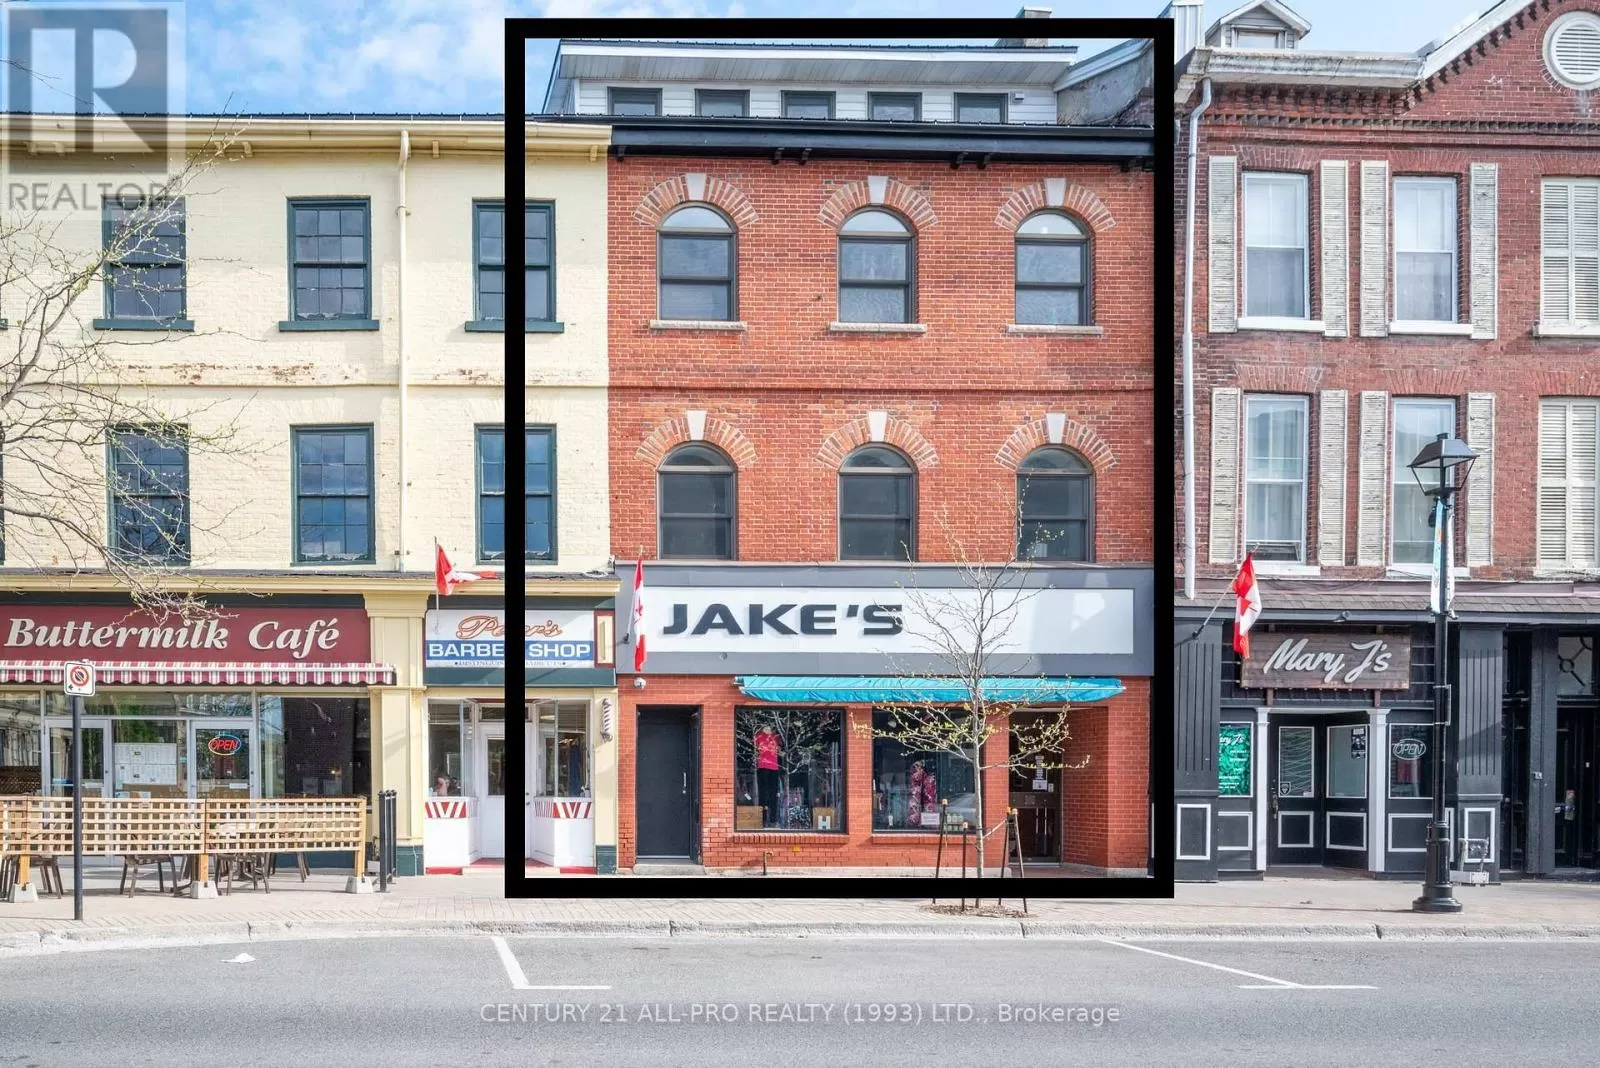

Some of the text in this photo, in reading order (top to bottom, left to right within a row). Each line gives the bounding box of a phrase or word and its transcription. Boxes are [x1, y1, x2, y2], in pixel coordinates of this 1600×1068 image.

[663, 604, 903, 635] JAKE'S
[4, 617, 341, 659] Buttermilk Café
[429, 643, 591, 657] BARBE SHOP
[1263, 638, 1393, 683] Mary J's
[211, 739, 239, 751] OPEN
[1395, 743, 1424, 755] OPEN
